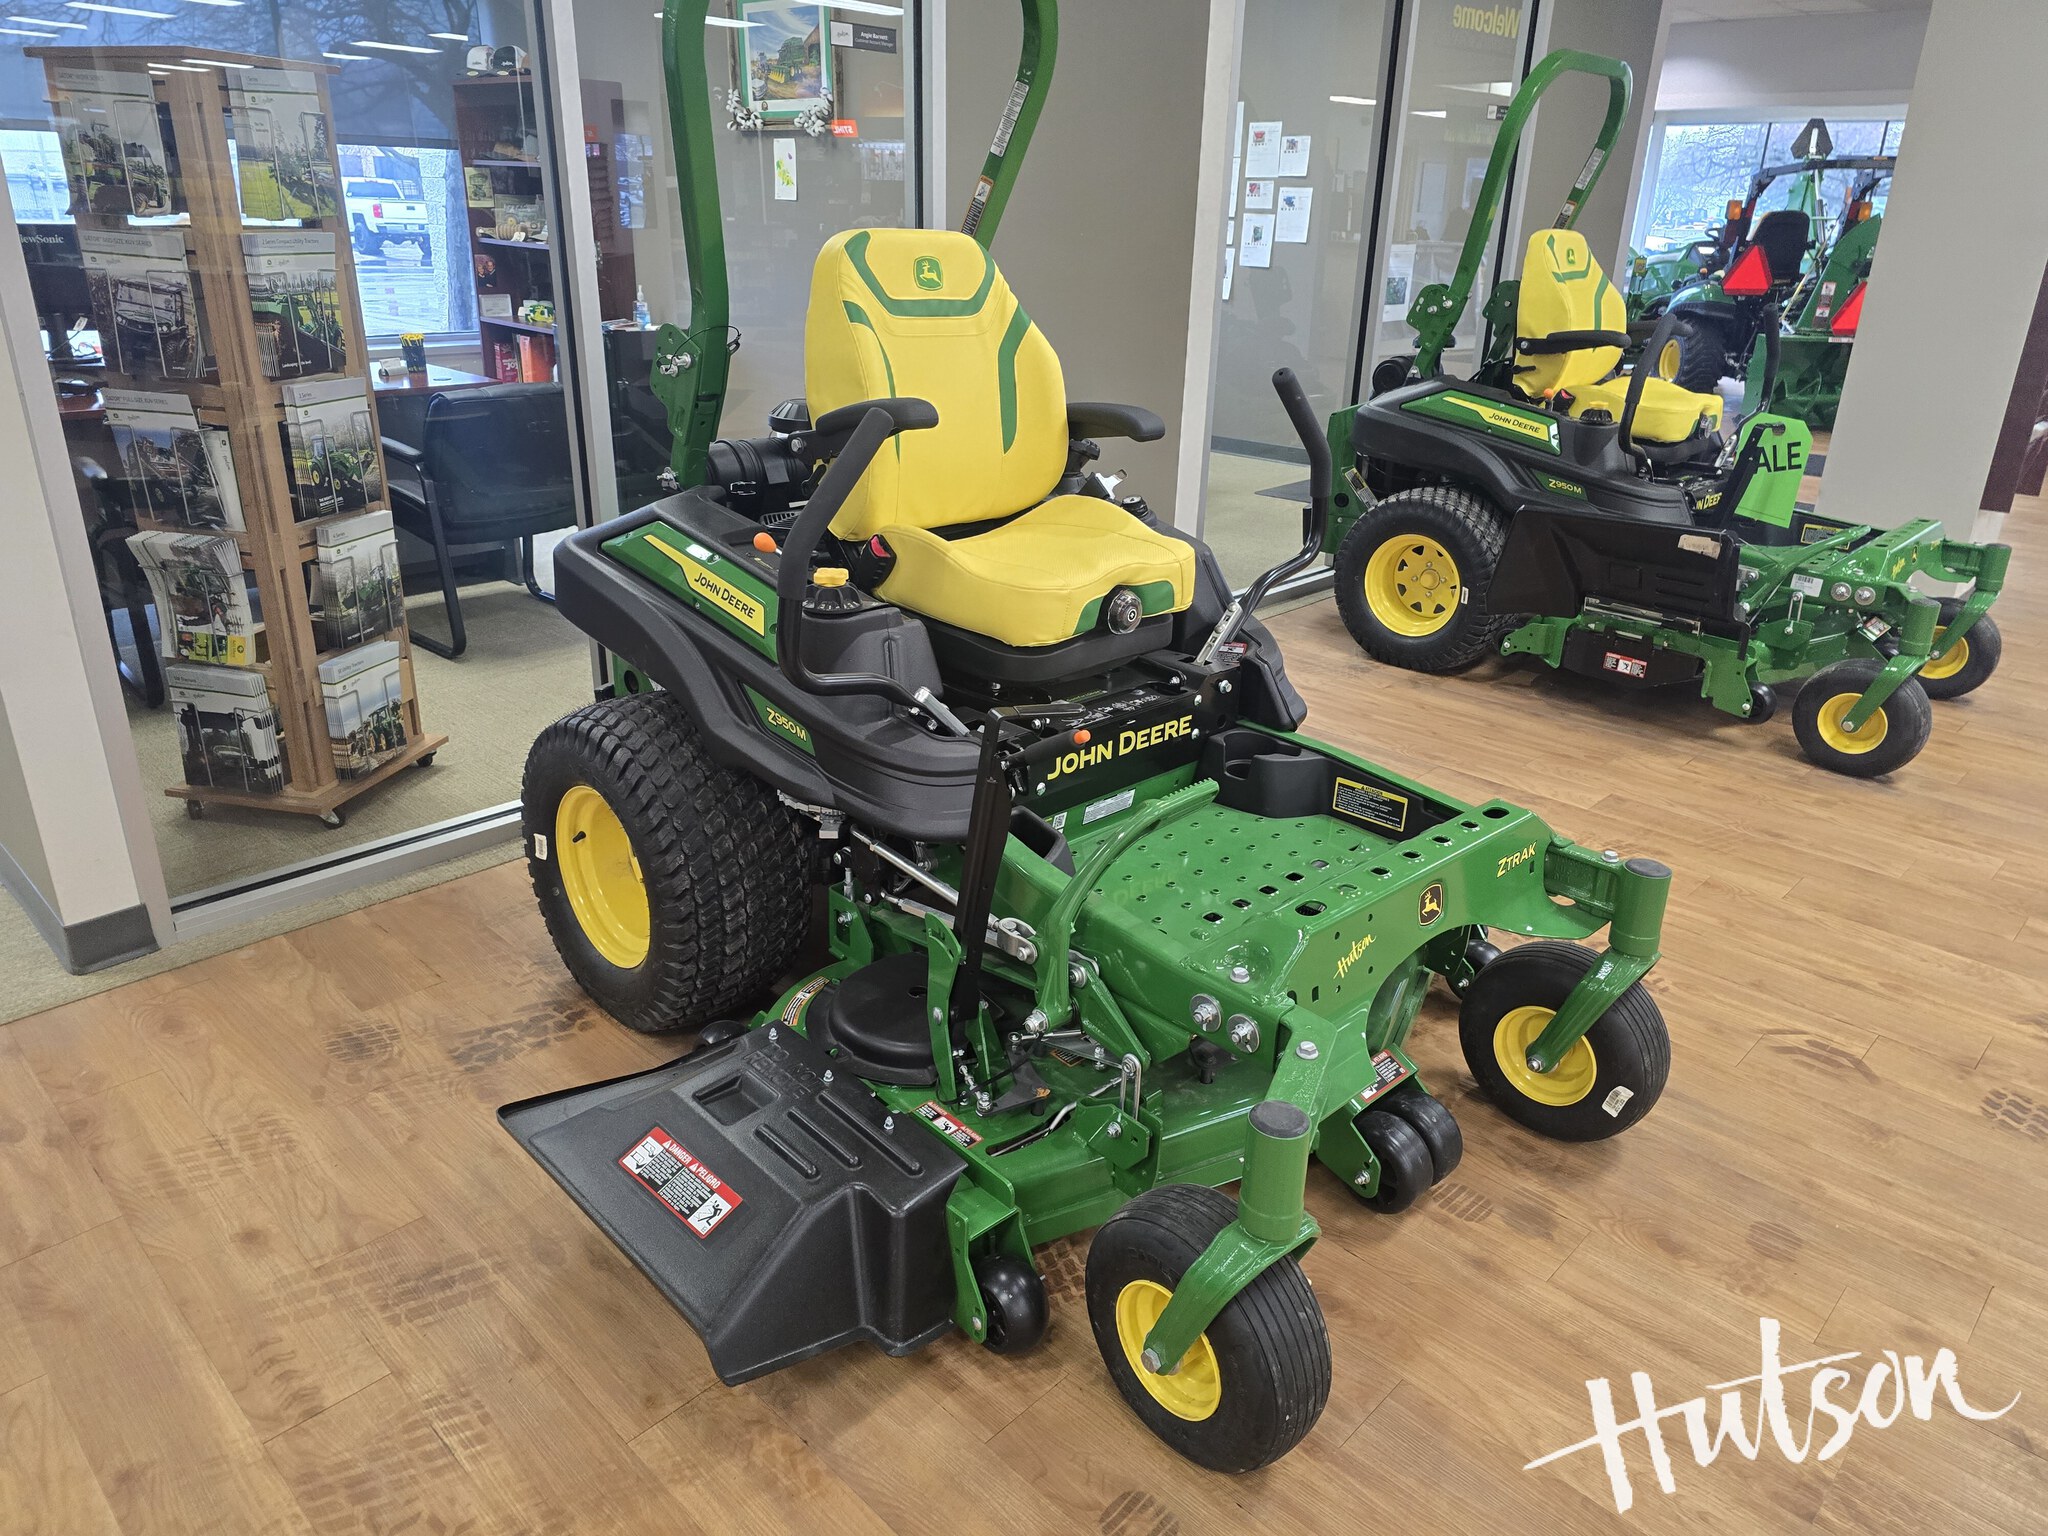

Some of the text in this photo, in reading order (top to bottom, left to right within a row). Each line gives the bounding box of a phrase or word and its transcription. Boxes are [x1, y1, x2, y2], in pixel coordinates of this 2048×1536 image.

[860, 31, 872, 40] Angie
[20, 234, 64, 244] iewSonic
[1489, 413, 1540, 434] JOHN DEERE
[1757, 441, 1802, 473] ALE
[1548, 478, 1582, 494] Z950M
[694, 572, 756, 618] JOHN DEERE
[766, 707, 806, 742] Z950M
[1047, 714, 1192, 780] JOHN DEERE
[1496, 840, 1537, 878] ZTRAK
[1333, 934, 1376, 980] Hutson
[668, 1142, 692, 1165] DANGER
[696, 1164, 722, 1189] PELIGRO
